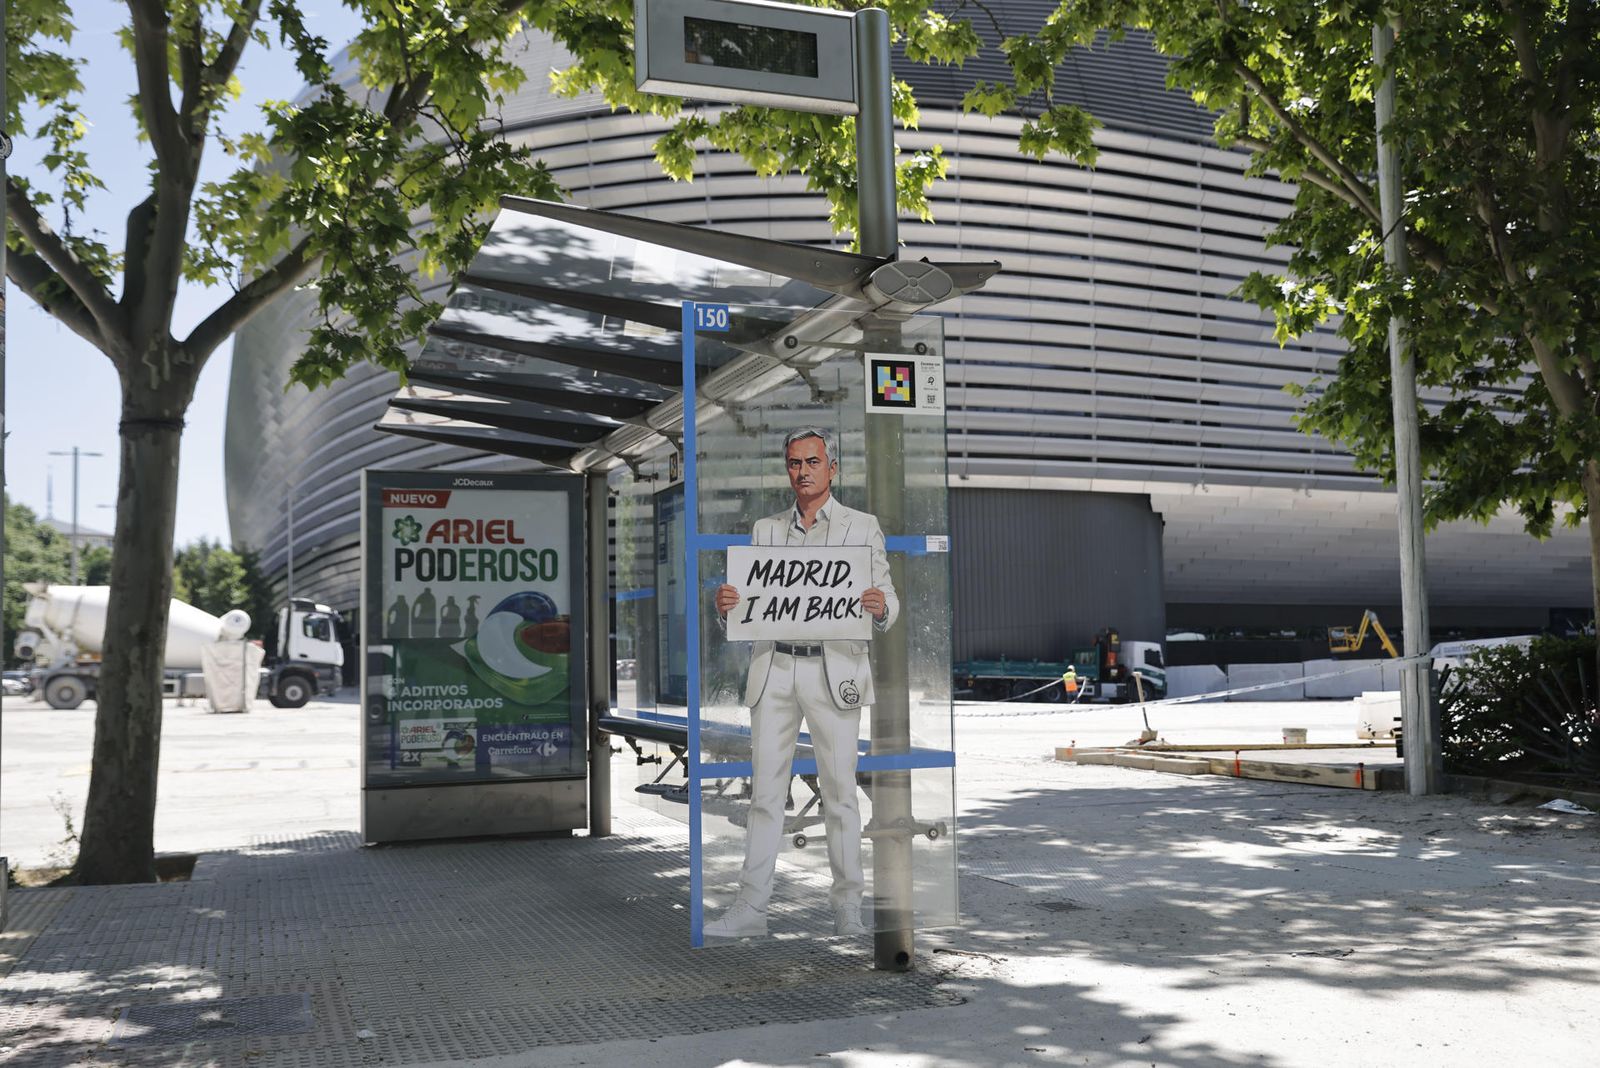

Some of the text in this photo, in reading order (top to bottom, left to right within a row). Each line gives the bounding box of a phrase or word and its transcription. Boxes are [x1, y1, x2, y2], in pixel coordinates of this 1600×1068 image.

[696, 307, 727, 328] 150
[452, 478, 494, 487] JCDecaux
[390, 493, 437, 504] NUEVO
[425, 519, 525, 544] ARIEL
[394, 548, 559, 582] PODEROSO
[746, 559, 853, 588] MADRID,
[741, 596, 760, 624] I
[762, 596, 801, 622] AM
[401, 685, 468, 697] ADITIVOS
[387, 698, 504, 712] INCORPORADOS
[551, 731, 564, 740] EN
[487, 746, 534, 756] Carrefour
